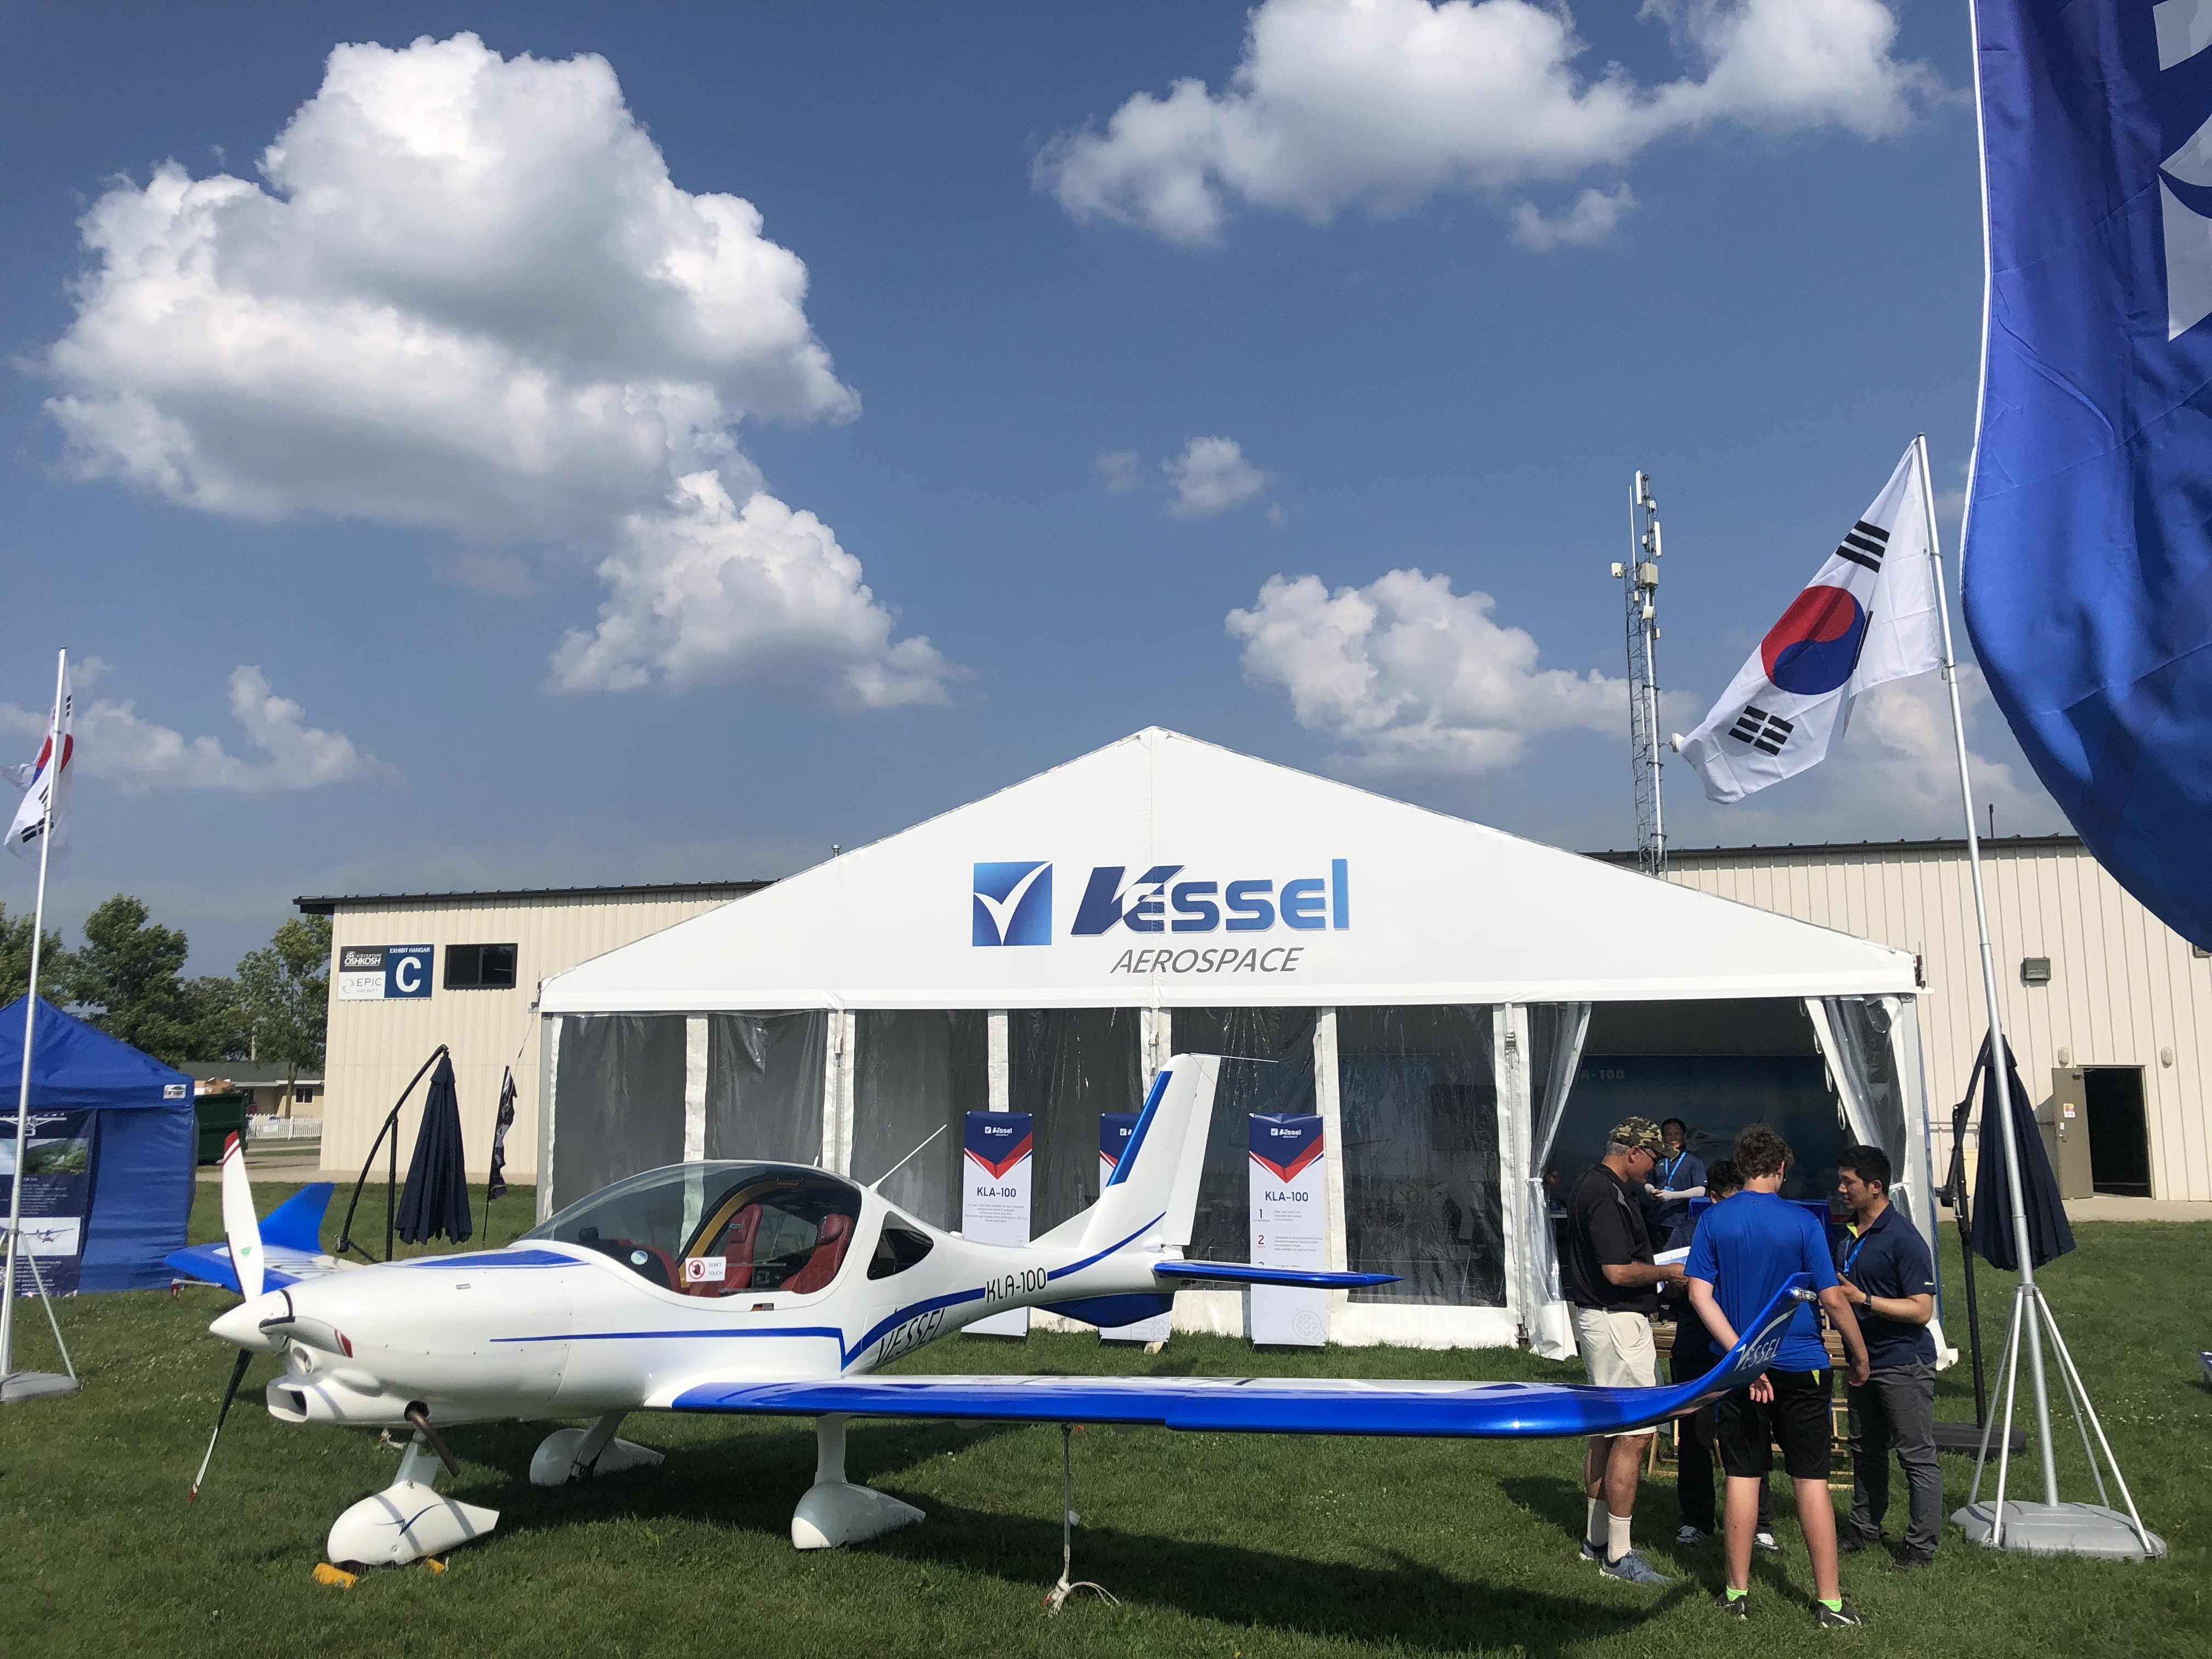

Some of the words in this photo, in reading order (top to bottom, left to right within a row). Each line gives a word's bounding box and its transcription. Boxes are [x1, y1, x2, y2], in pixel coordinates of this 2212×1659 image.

[1070, 858, 1350, 937] Vessel
[344, 957, 382, 965] OSHKOSH
[1109, 947, 1305, 974] AEROSPACE
[396, 956, 421, 992] C
[357, 978, 382, 987] EPIC
[977, 1186, 1017, 1198] KLA-100
[1265, 1191, 1308, 1202] KLA-100
[1259, 1209, 1262, 1219] 1
[1258, 1234, 1265, 1245] 2
[986, 1267, 1046, 1303] KLA-100
[875, 1307, 946, 1364] VESSEL
